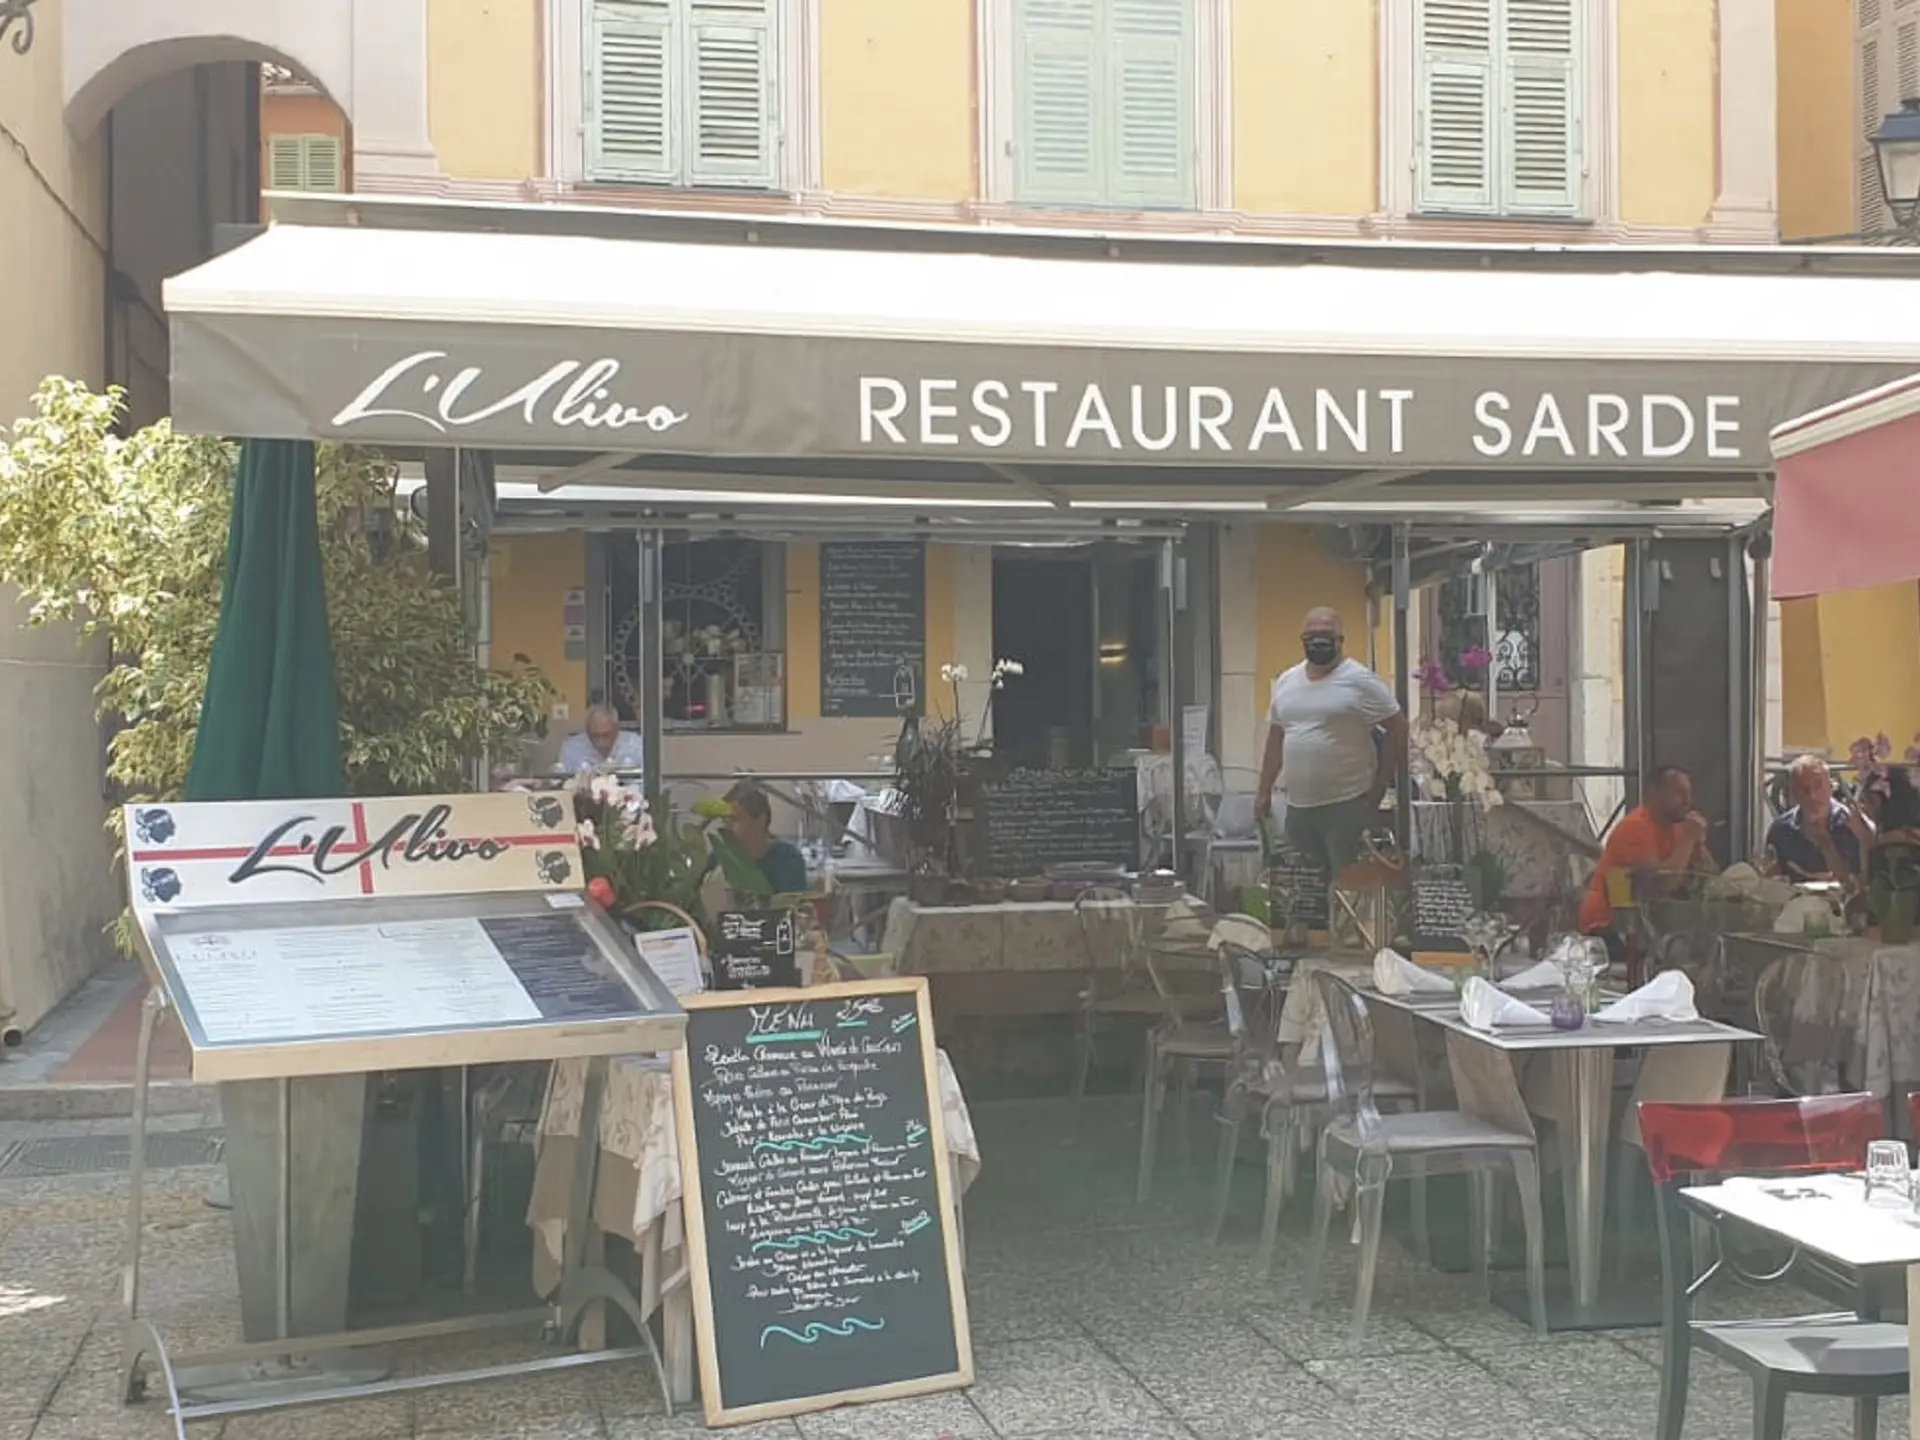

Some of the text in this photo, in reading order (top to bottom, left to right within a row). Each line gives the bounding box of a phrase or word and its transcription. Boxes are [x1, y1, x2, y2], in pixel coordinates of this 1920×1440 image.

[331, 350, 690, 433] L'Ulivo
[858, 376, 1741, 460] RESTAURANT SARDE
[228, 804, 508, 884] L'Ulivo
